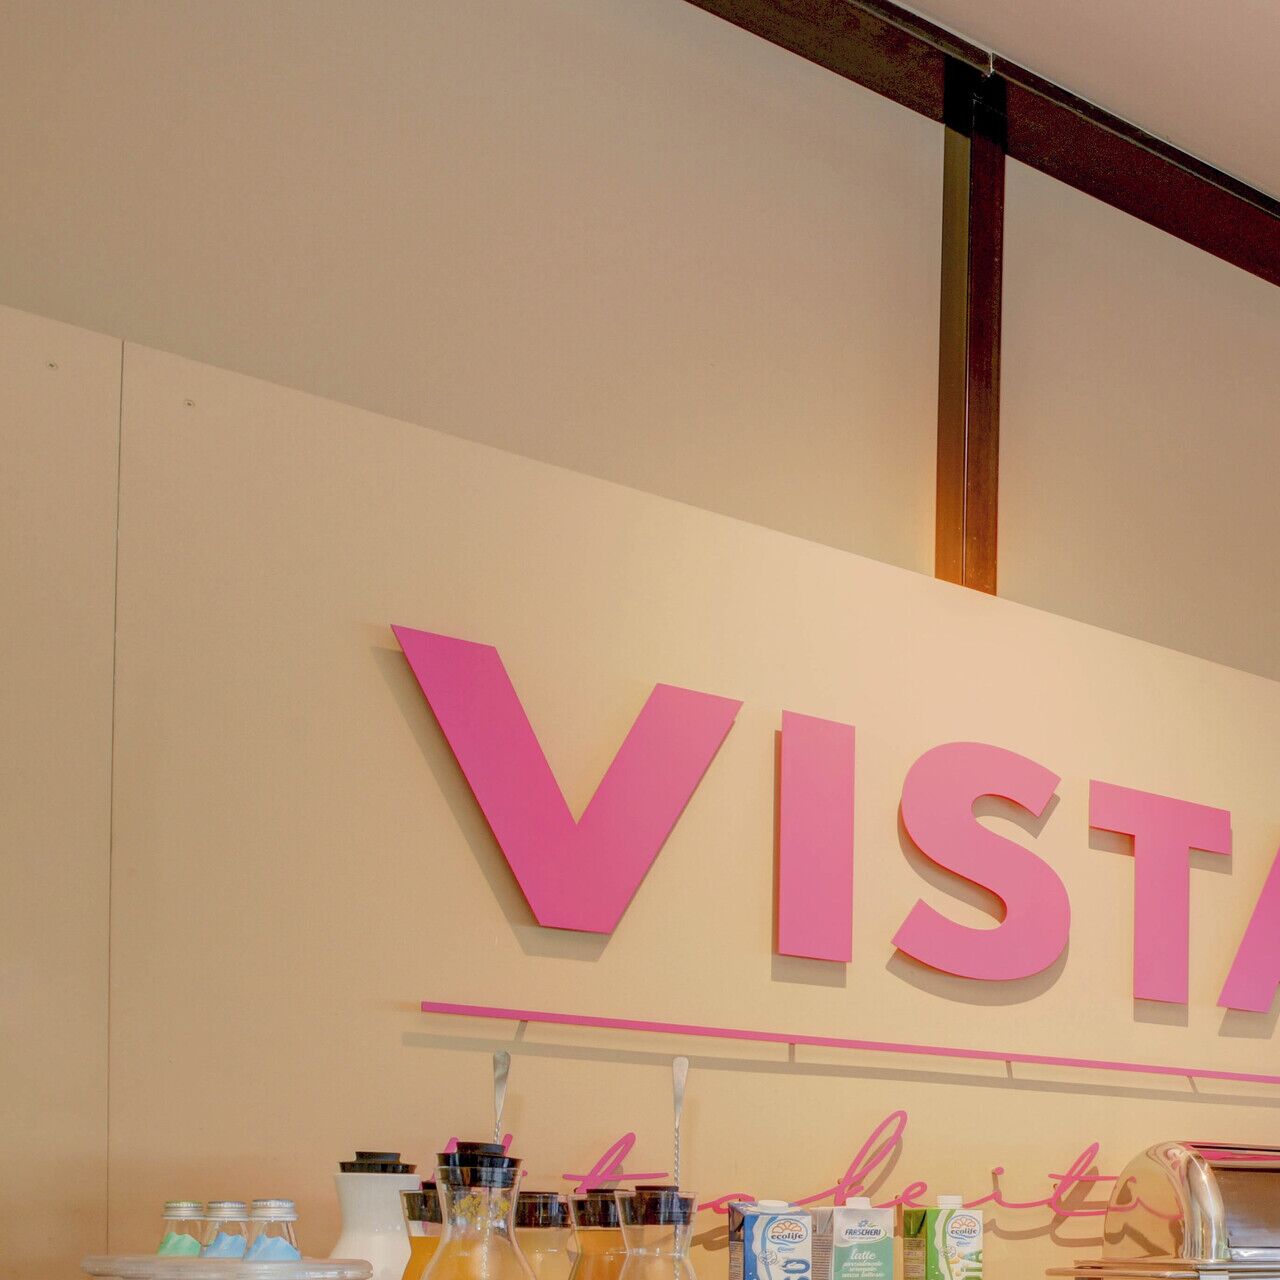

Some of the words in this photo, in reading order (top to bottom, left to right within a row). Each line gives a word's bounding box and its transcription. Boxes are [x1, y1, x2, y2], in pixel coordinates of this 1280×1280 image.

[950, 1227, 978, 1235] ecolife
[770, 1232, 804, 1240] ecolife
[850, 1248, 877, 1260] latte
